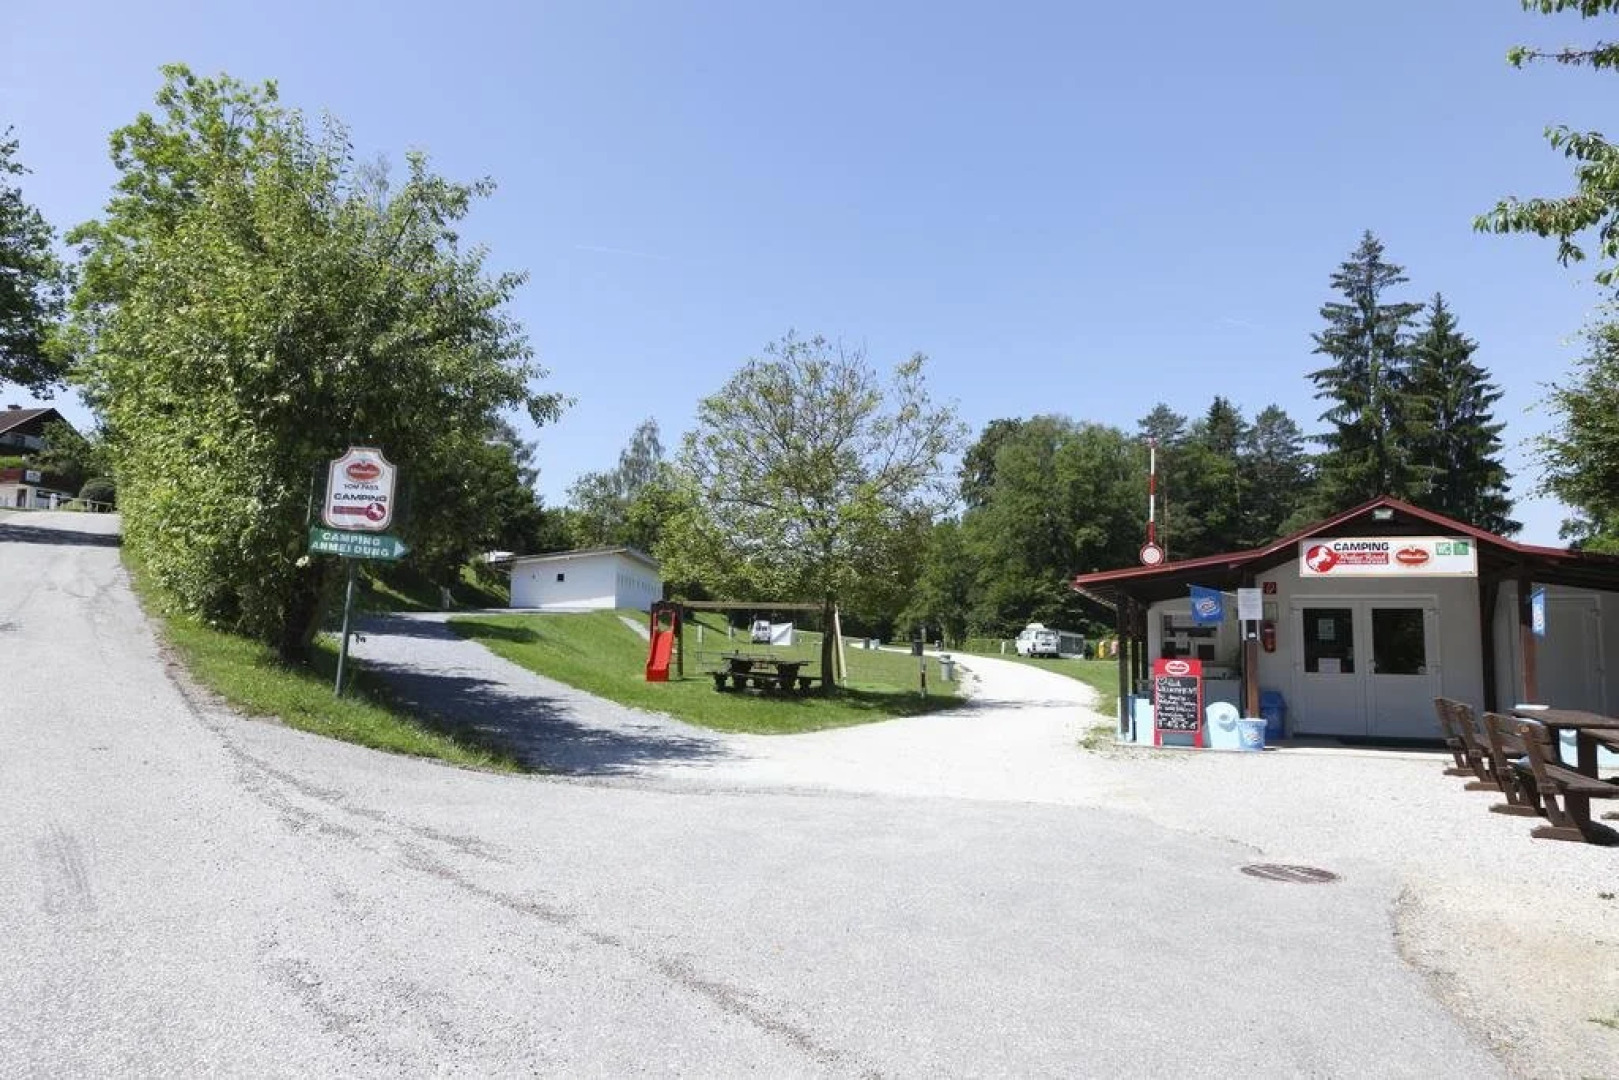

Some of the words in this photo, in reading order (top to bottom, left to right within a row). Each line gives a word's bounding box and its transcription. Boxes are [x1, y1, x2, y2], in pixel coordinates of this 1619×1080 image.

[333, 493, 388, 502] CAMPING
[322, 532, 380, 546] CAMPING
[1333, 542, 1389, 551] CAMPING
